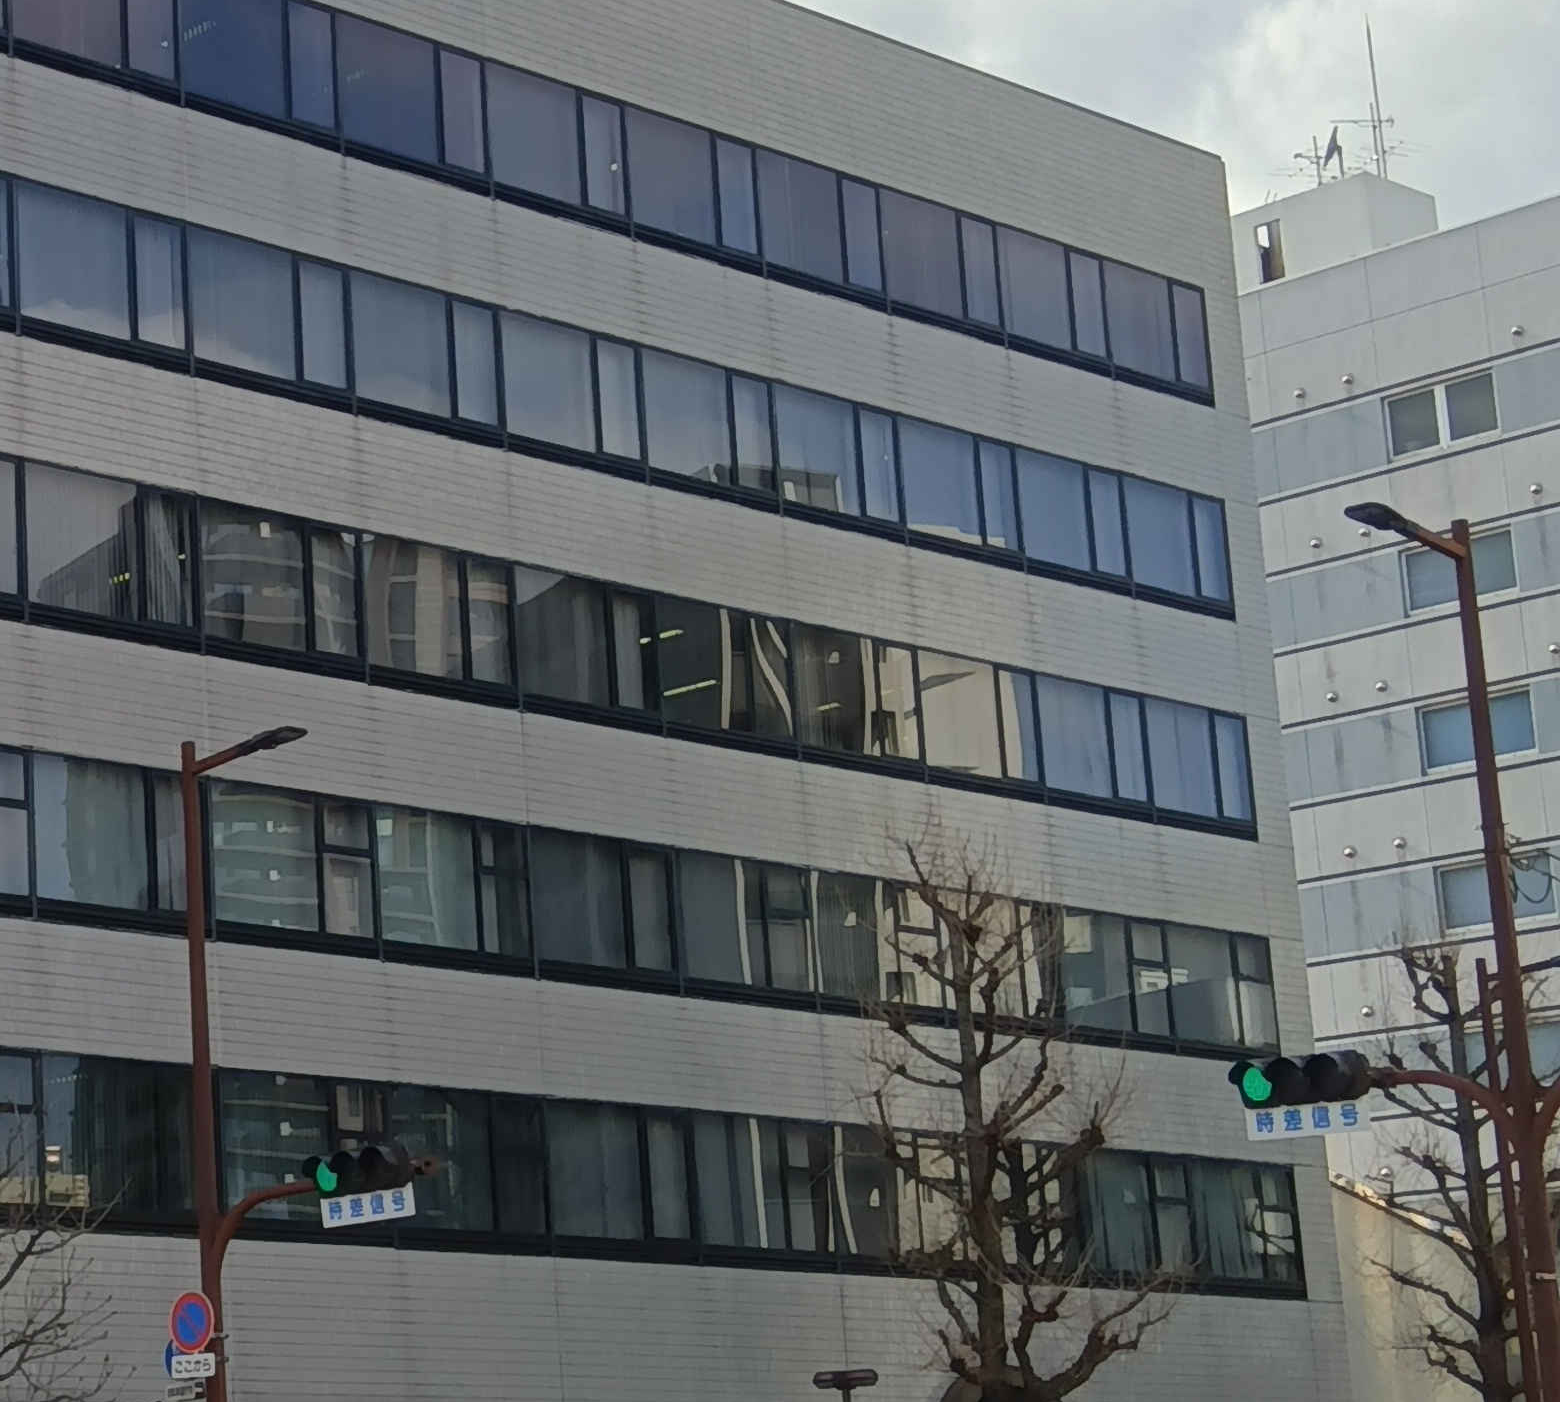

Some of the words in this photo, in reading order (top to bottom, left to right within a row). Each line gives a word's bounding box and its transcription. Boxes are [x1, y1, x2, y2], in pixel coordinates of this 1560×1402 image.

[1255, 1102, 1359, 1133] 時差信号
[328, 1190, 405, 1220] 時差信号
